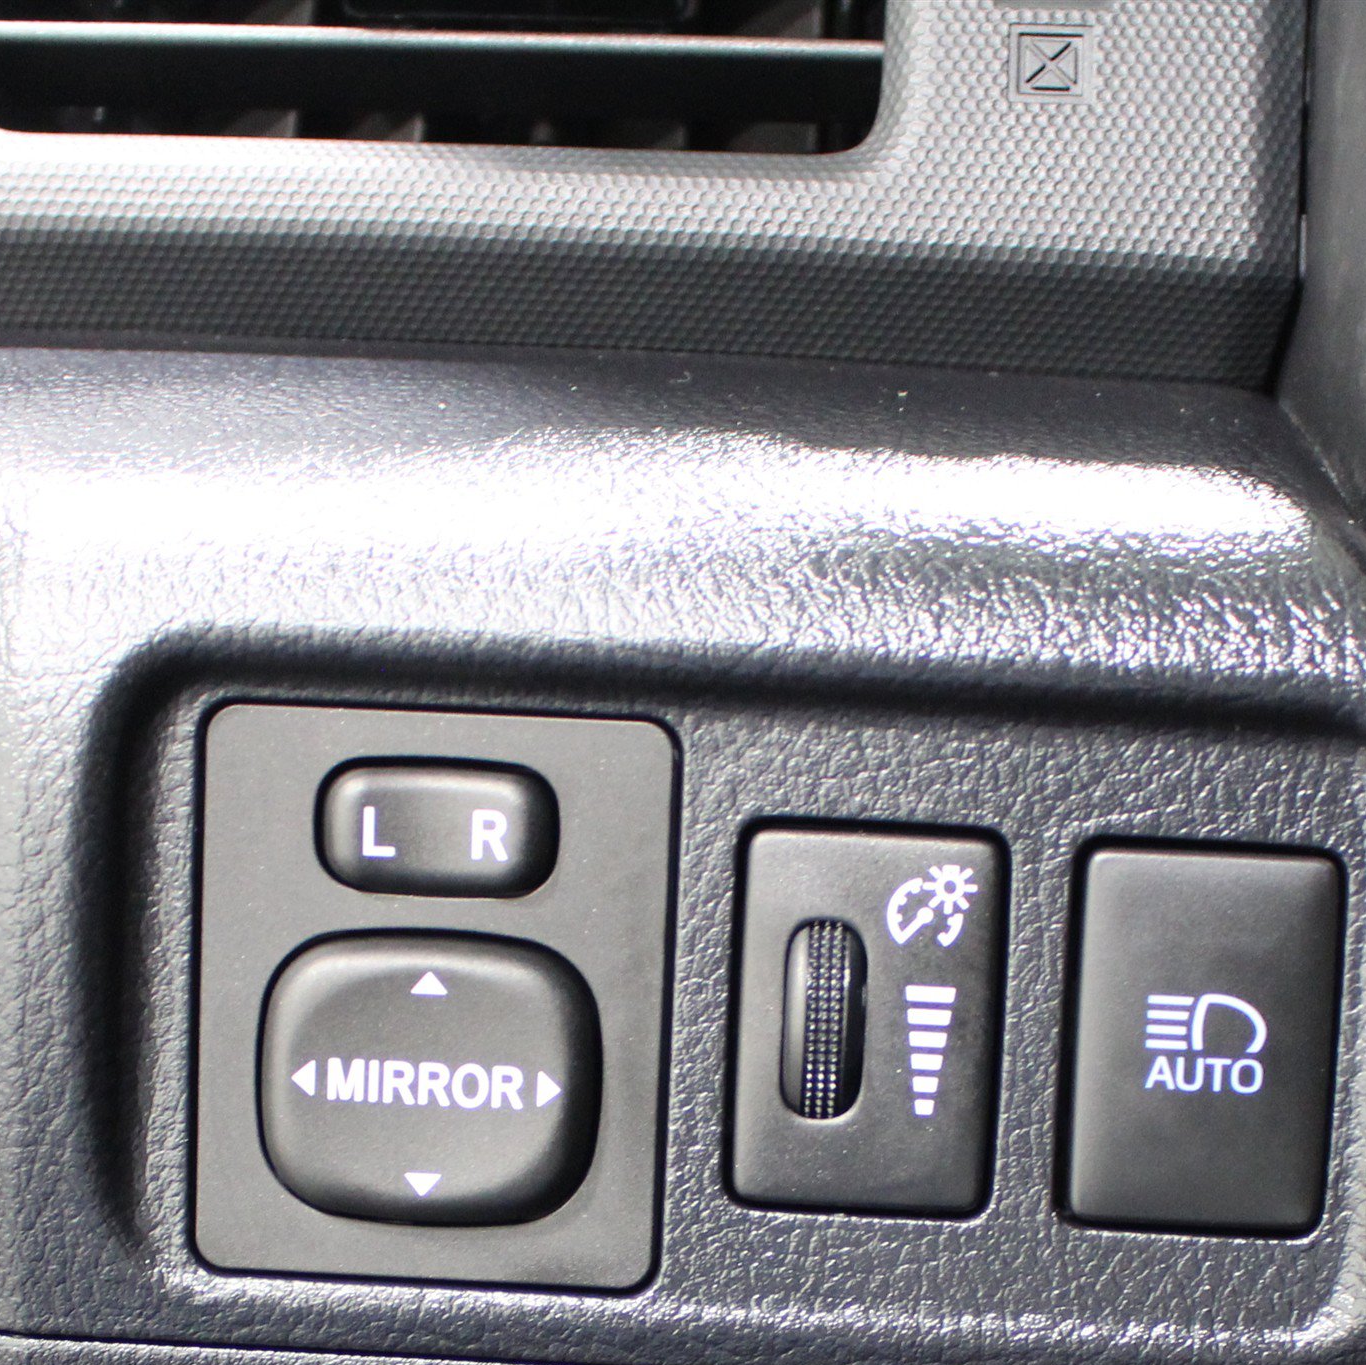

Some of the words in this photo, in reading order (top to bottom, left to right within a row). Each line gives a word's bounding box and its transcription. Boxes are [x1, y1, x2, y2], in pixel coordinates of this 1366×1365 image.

[362, 805, 396, 858] L
[470, 808, 509, 862] R
[326, 1056, 525, 1111] MIRROR
[1144, 1055, 1265, 1094] AUTO
